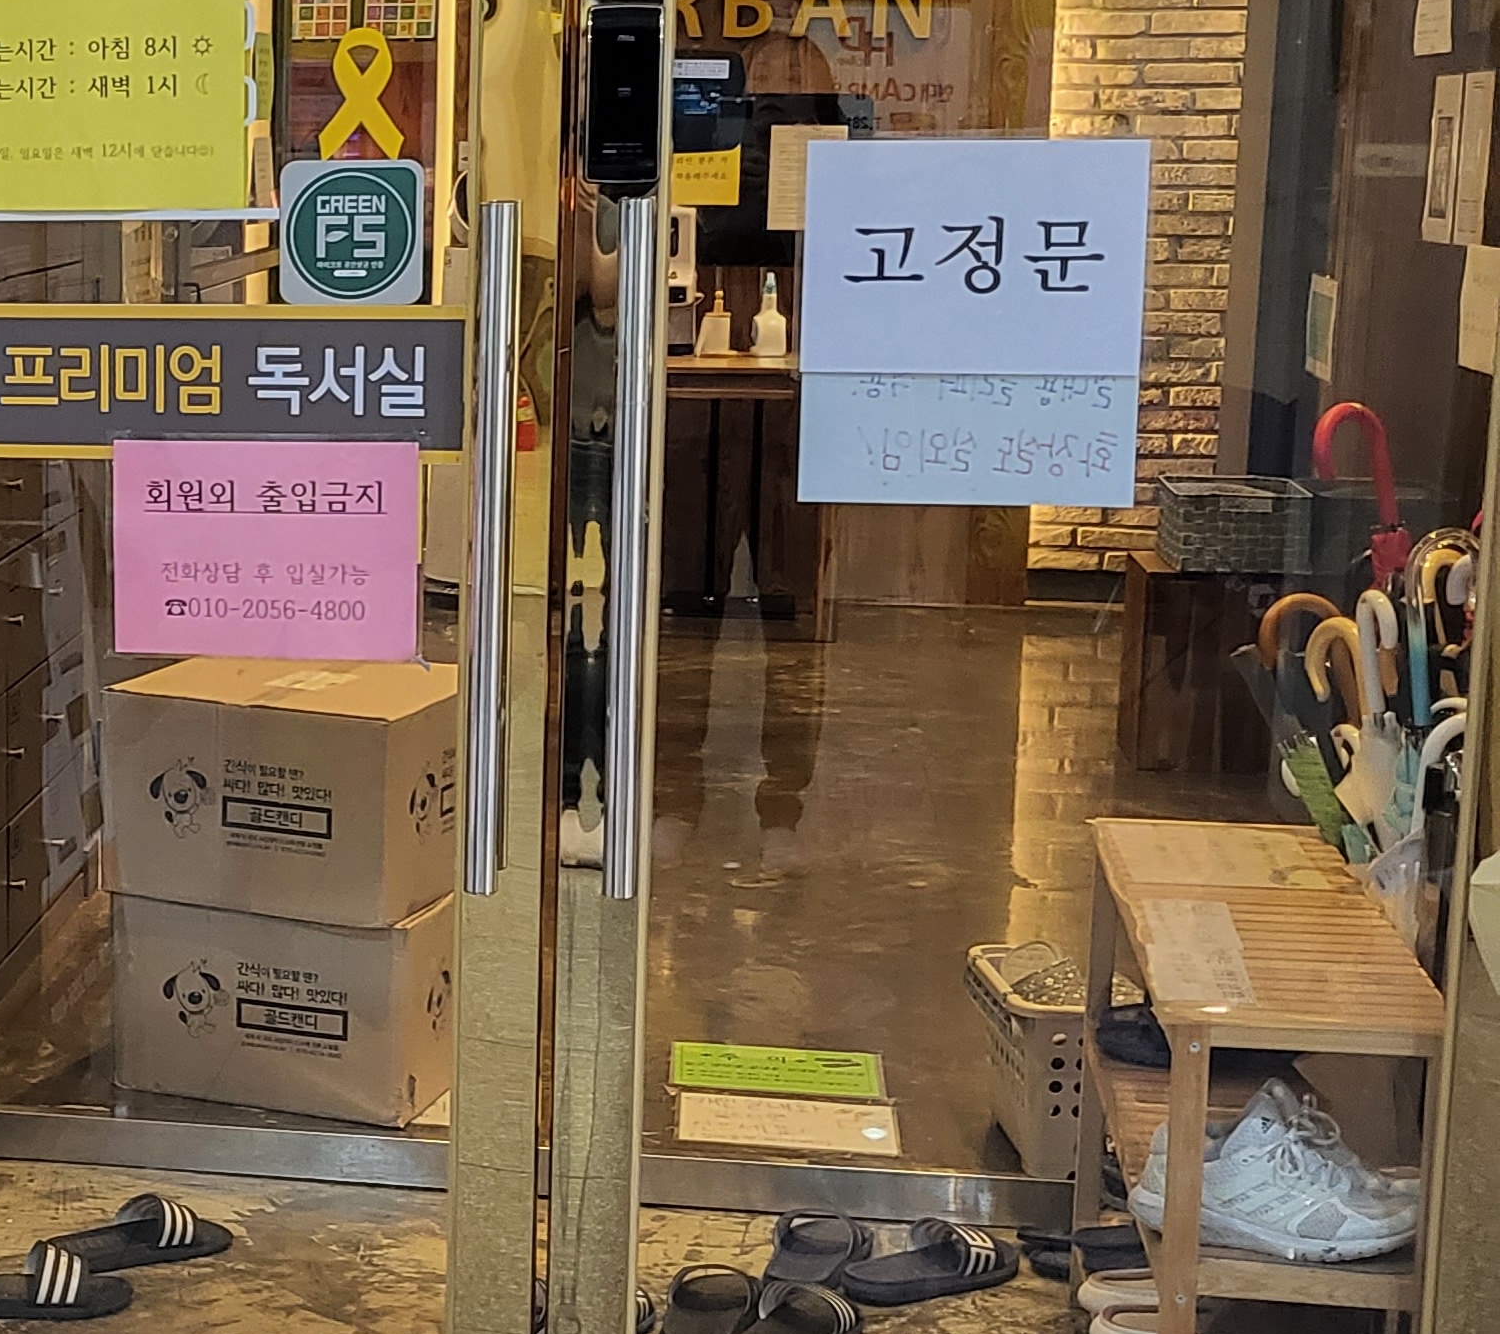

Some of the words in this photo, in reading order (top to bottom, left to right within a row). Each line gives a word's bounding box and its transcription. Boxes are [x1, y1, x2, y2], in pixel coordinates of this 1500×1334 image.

[87, 36, 131, 61] 아침
[144, 35, 178, 60] 8시
[87, 74, 131, 98] 새벽
[147, 73, 178, 97] 1시
[315, 193, 387, 214] GREEN
[843, 215, 1105, 294] 고정문
[0, 343, 224, 416] 프리미엄
[247, 344, 428, 419] 독서실
[144, 478, 237, 514] 회원외
[256, 478, 388, 515] 출입금지
[160, 560, 243, 586] 전화상담
[253, 561, 275, 587] 후
[285, 561, 371, 588] 입실가능
[223, 758, 257, 777] 간식이
[292, 785, 332, 803] 맛있다!
[248, 806, 304, 829] 골드캔디
[236, 961, 270, 979] 간식이
[306, 988, 348, 1006] 맛있다!
[263, 1008, 319, 1031] 골드캔디
